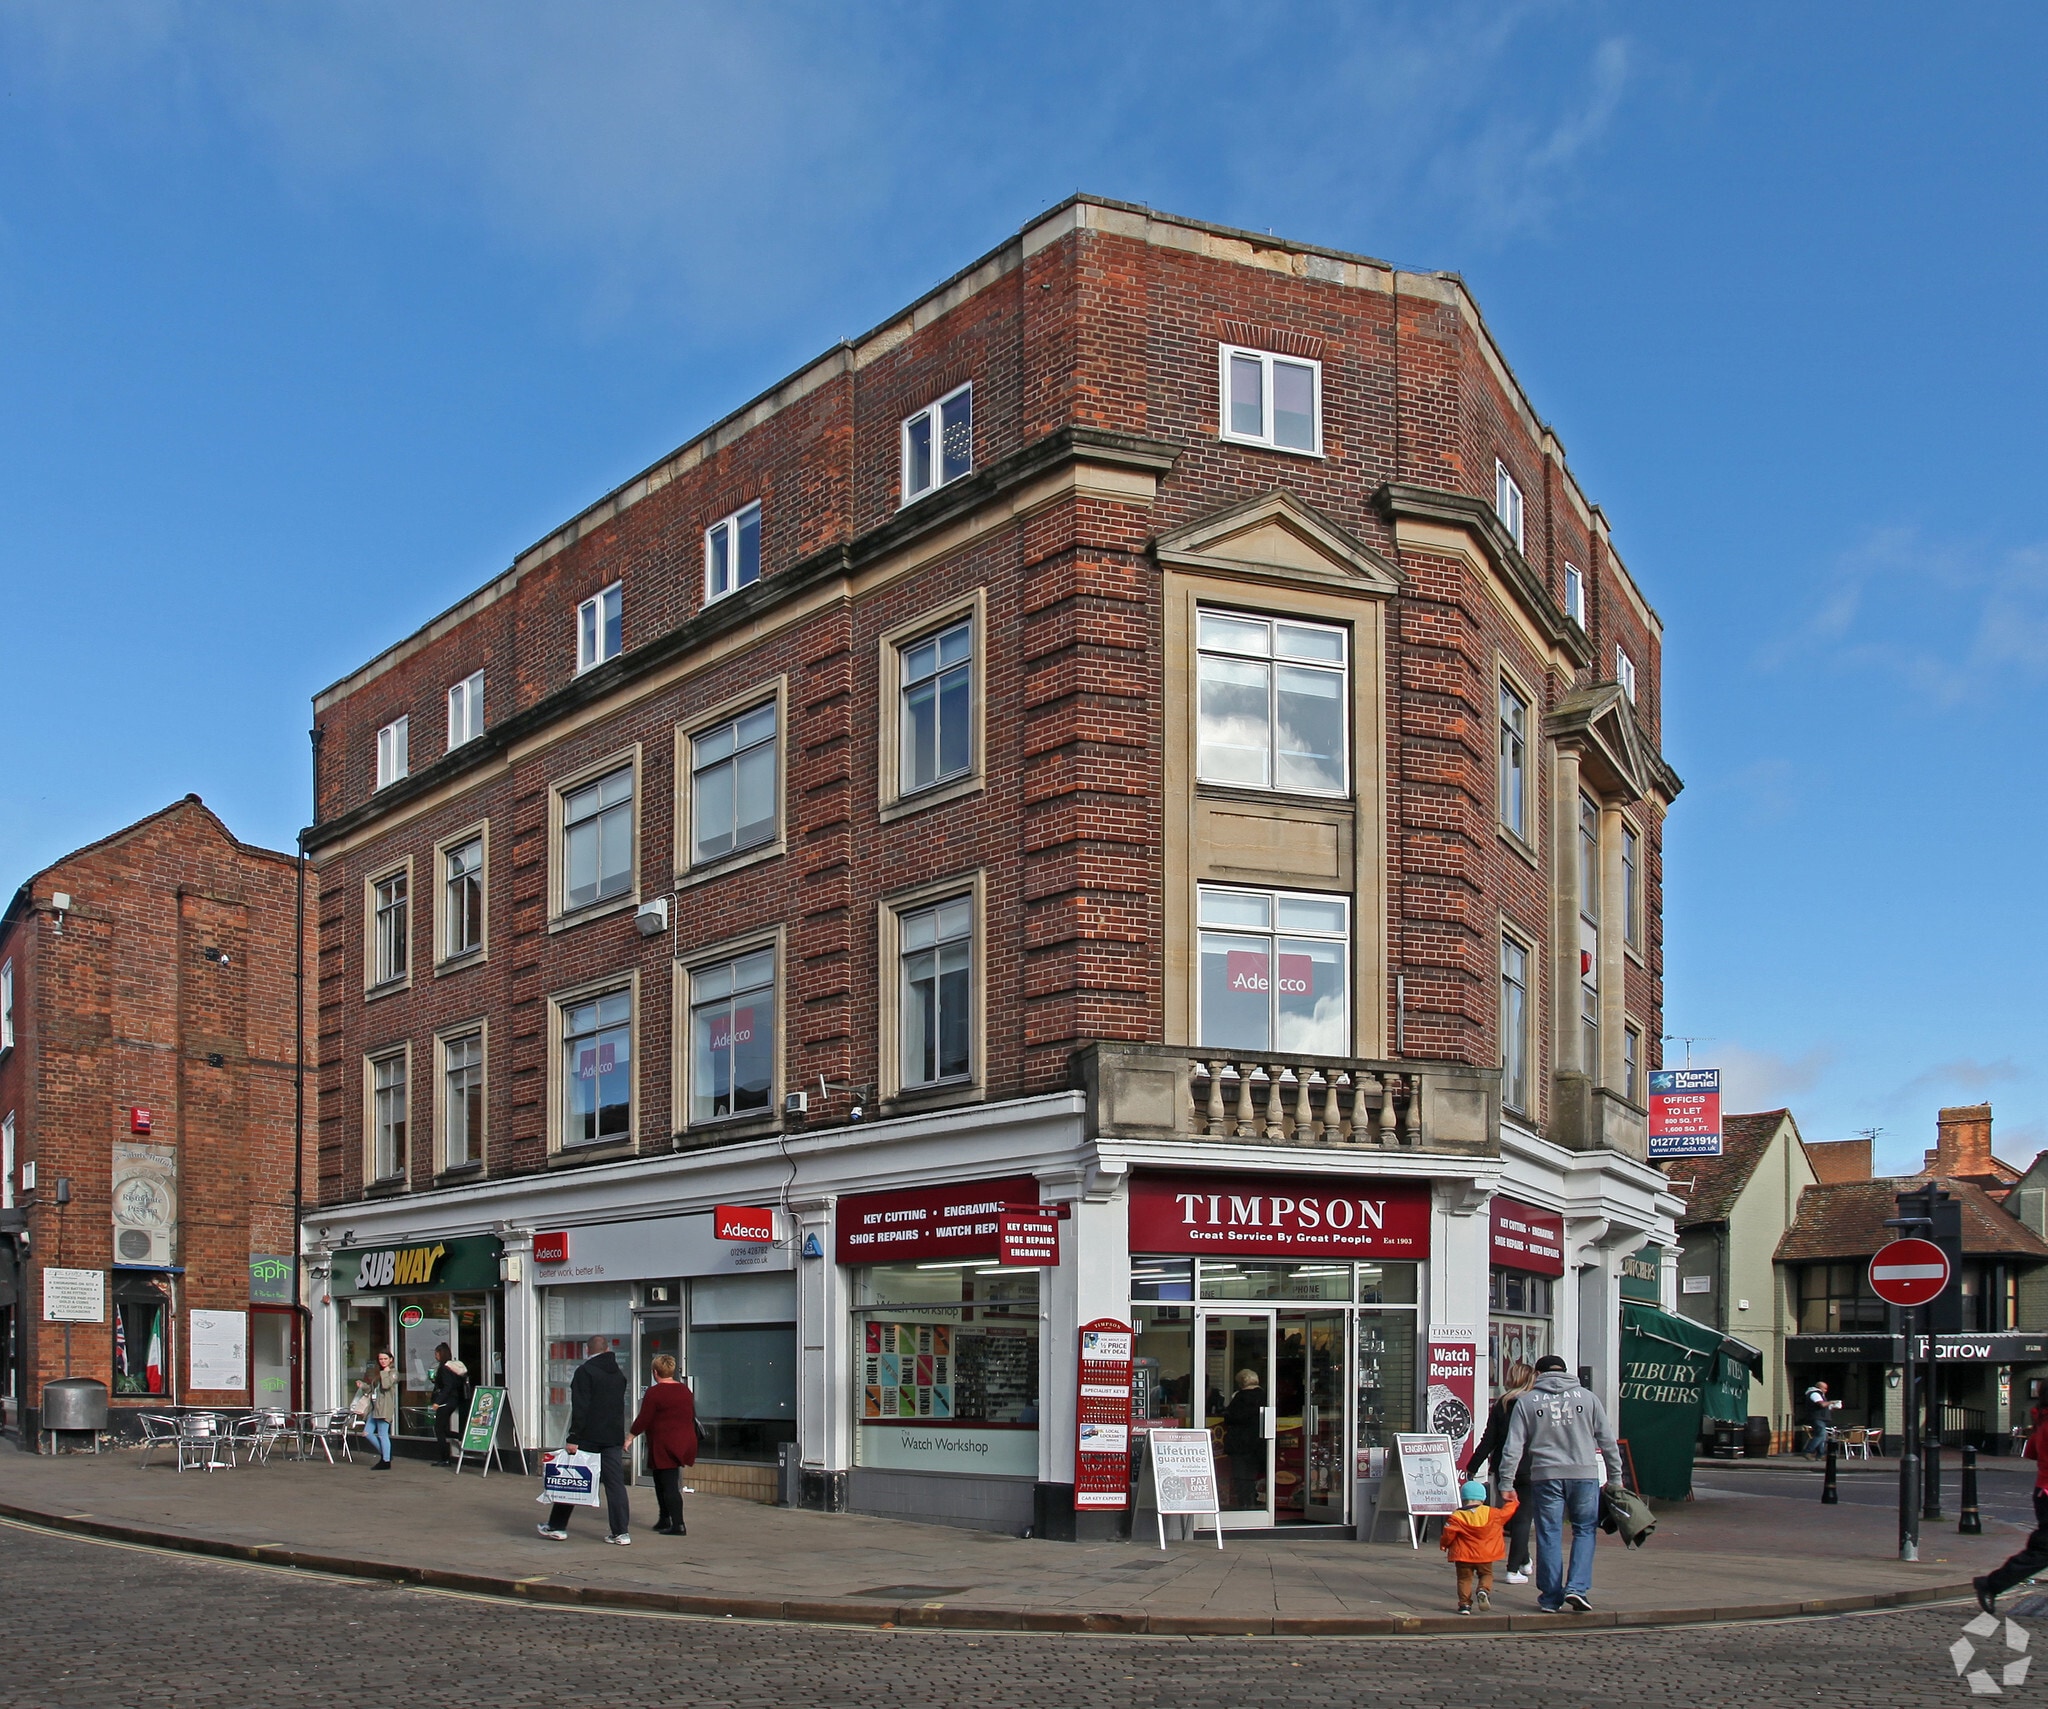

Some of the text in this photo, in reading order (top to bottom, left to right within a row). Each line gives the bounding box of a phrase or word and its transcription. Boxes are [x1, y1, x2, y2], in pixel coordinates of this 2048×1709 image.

[1233, 973, 1306, 992] Adecco
[1676, 1072, 1713, 1081] Mark
[1676, 1073, 1717, 1088] Daniel
[1663, 1096, 1706, 1104] OFFICES
[1683, 1107, 1702, 1115] LET
[1650, 1136, 1718, 1147] 01277 231914
[863, 1213, 883, 1224] KEY
[884, 1208, 927, 1222] CUTTING
[1175, 1193, 1387, 1230] TIMPSON
[722, 1222, 770, 1239] Adecco
[1006, 1222, 1053, 1232] KEY CUTTING
[849, 1233, 875, 1245] SHOE
[877, 1229, 919, 1241] REPAIRS
[935, 1224, 972, 1238] WATCH
[1004, 1235, 1056, 1245] SHOE REPAIRS
[1189, 1230, 1373, 1245] Great Service By Great People
[1383, 1237, 1395, 1245] Est
[1494, 1235, 1506, 1247] SHOE
[1507, 1238, 1524, 1251] REPAIRS
[536, 1248, 562, 1259] Adecco
[730, 1248, 746, 1256] 01296
[1010, 1248, 1051, 1258] ENGRAVING
[355, 1241, 446, 1290] SUBWAY
[253, 1260, 287, 1283] aph
[539, 1265, 605, 1278] better work, better life
[1094, 1322, 1121, 1330] TIMPSON
[1434, 1349, 1469, 1361] Watch
[1430, 1363, 1473, 1379] Repairs
[1532, 1391, 1582, 1402] JAPAN
[1618, 1382, 1701, 1404] UTCHERS
[1550, 1401, 1573, 1419] 54
[901, 1437, 988, 1456] Watch Workshop
[1157, 1445, 1206, 1456] Lifetime
[1404, 1444, 1444, 1453] ENGRAVING
[1158, 1455, 1207, 1465] guarantee
[546, 1478, 588, 1487] TRESPASS
[1190, 1477, 1208, 1485] PAY
